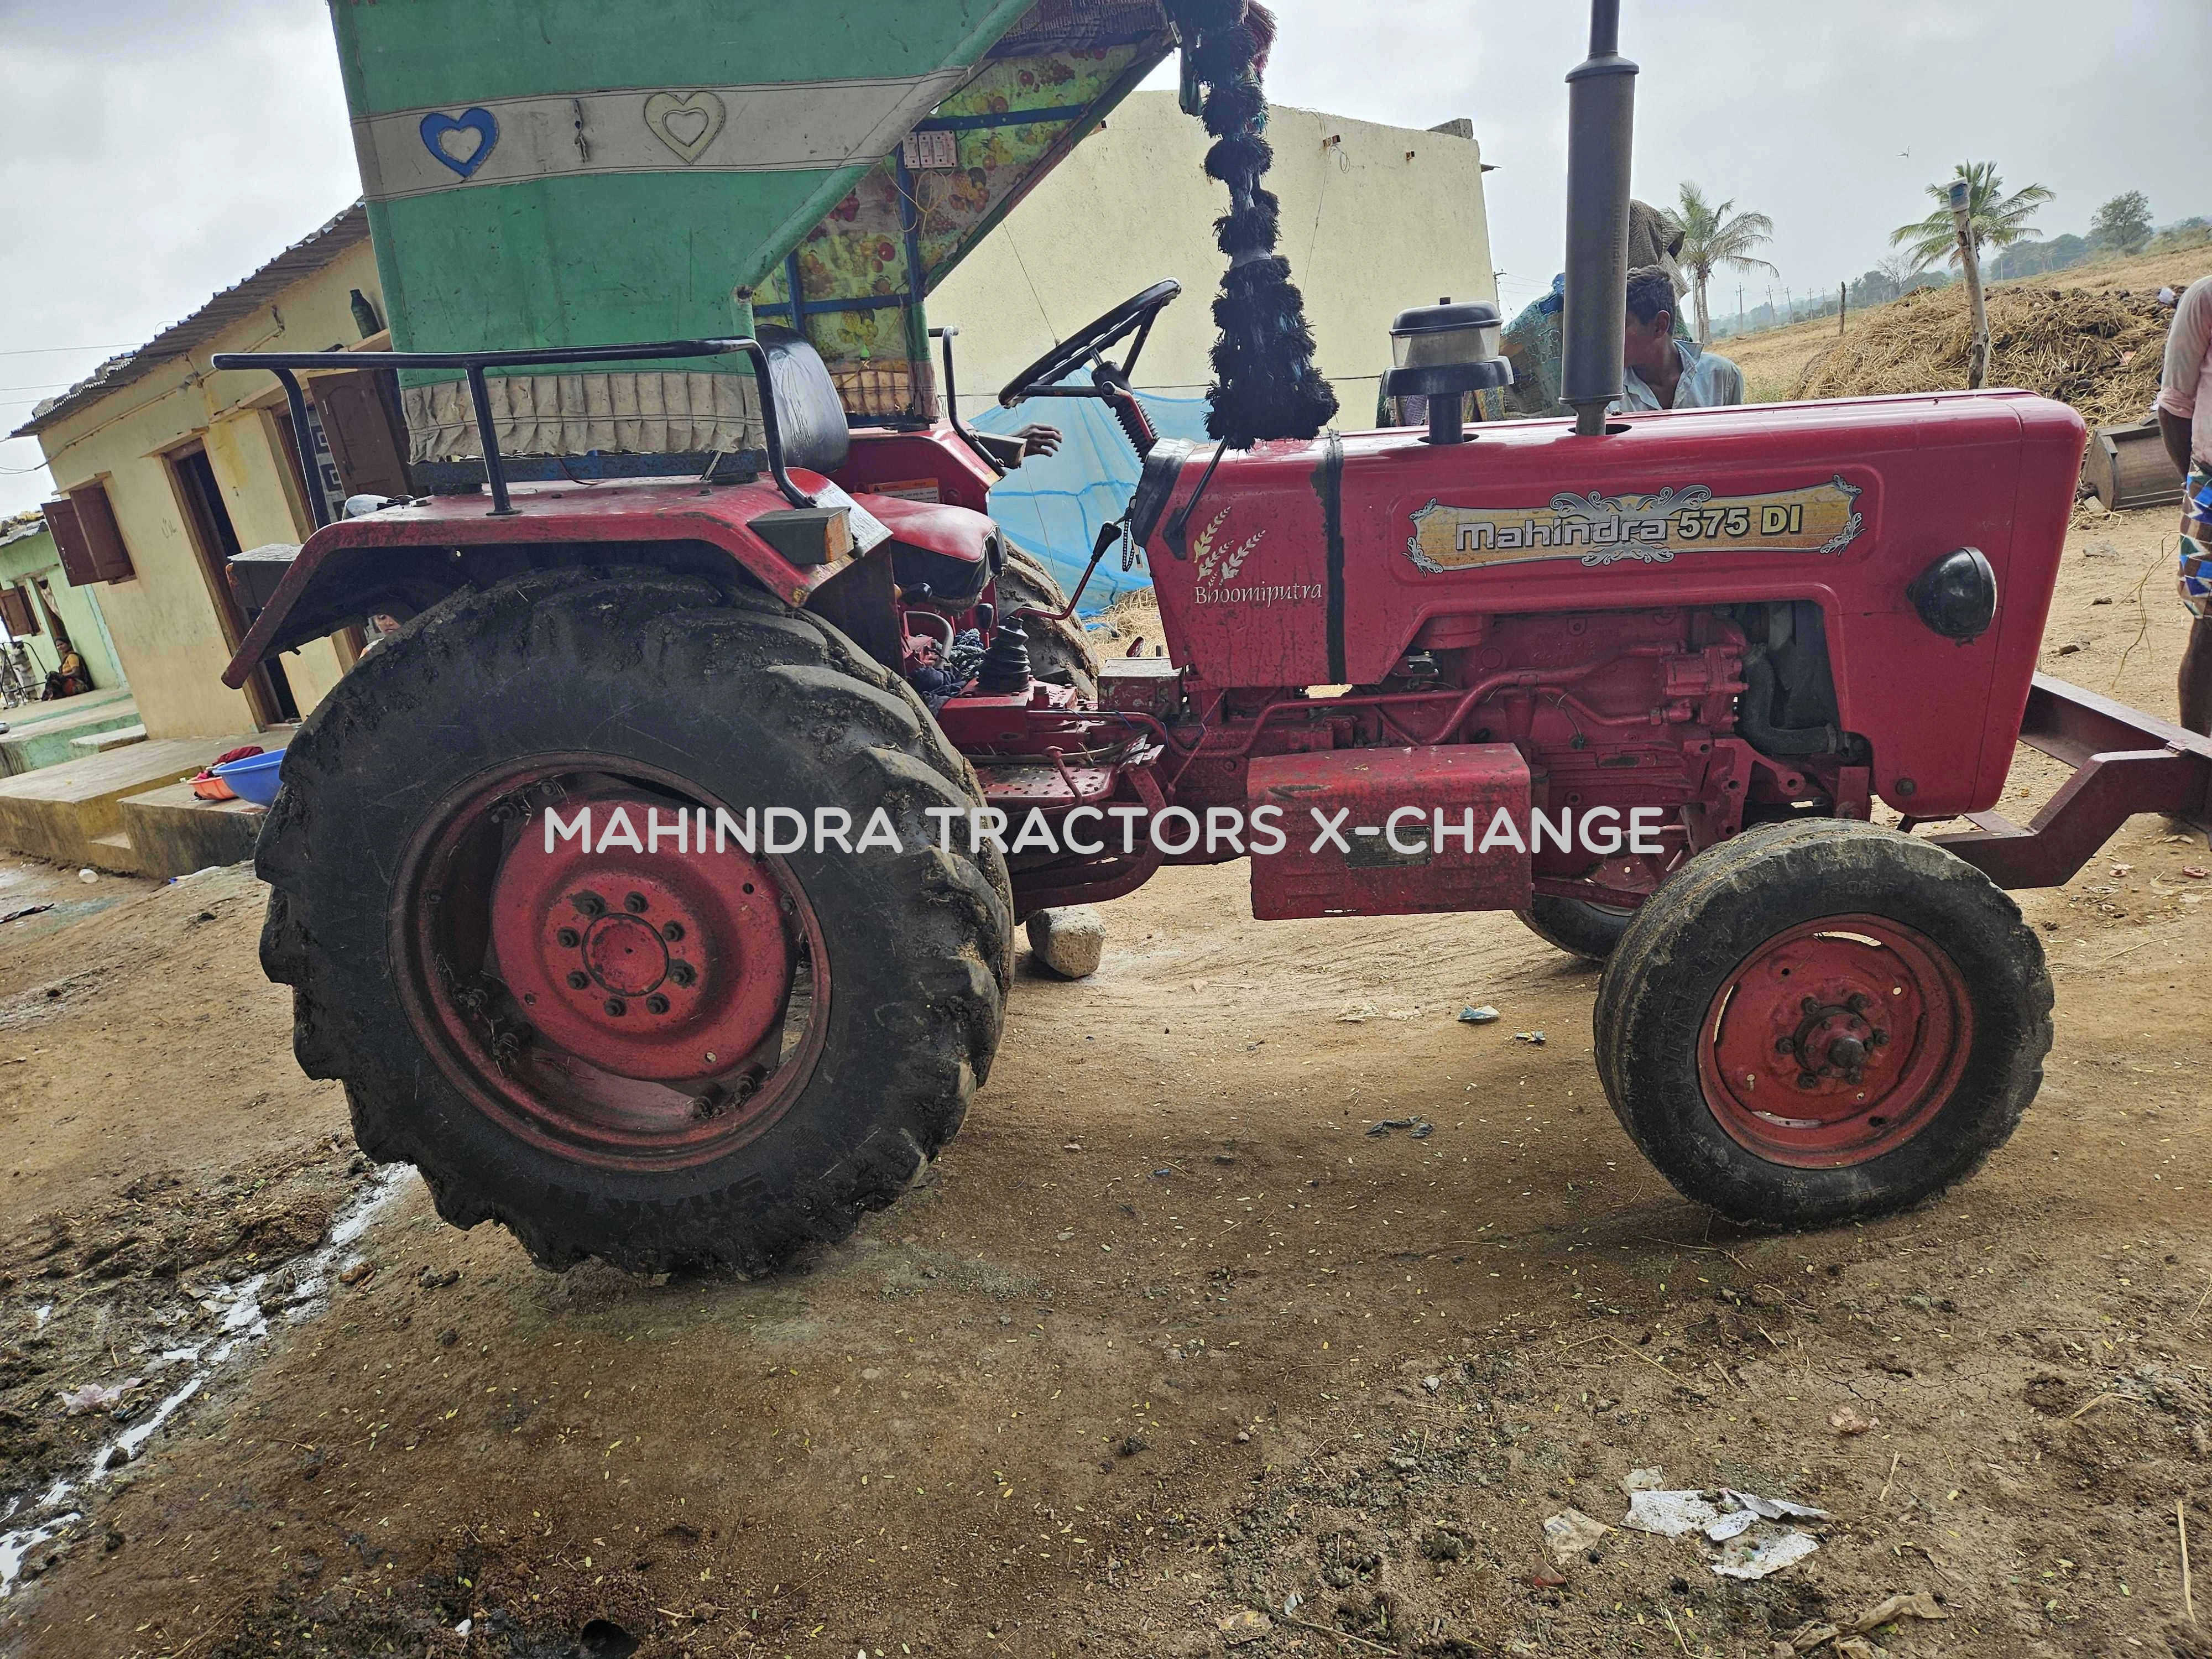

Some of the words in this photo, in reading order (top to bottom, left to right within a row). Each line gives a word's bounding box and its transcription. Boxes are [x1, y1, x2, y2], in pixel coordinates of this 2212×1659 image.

[1677, 507, 1749, 539] 575
[1761, 504, 1802, 535] DI
[1194, 581, 1322, 608] Bhoomiputra
